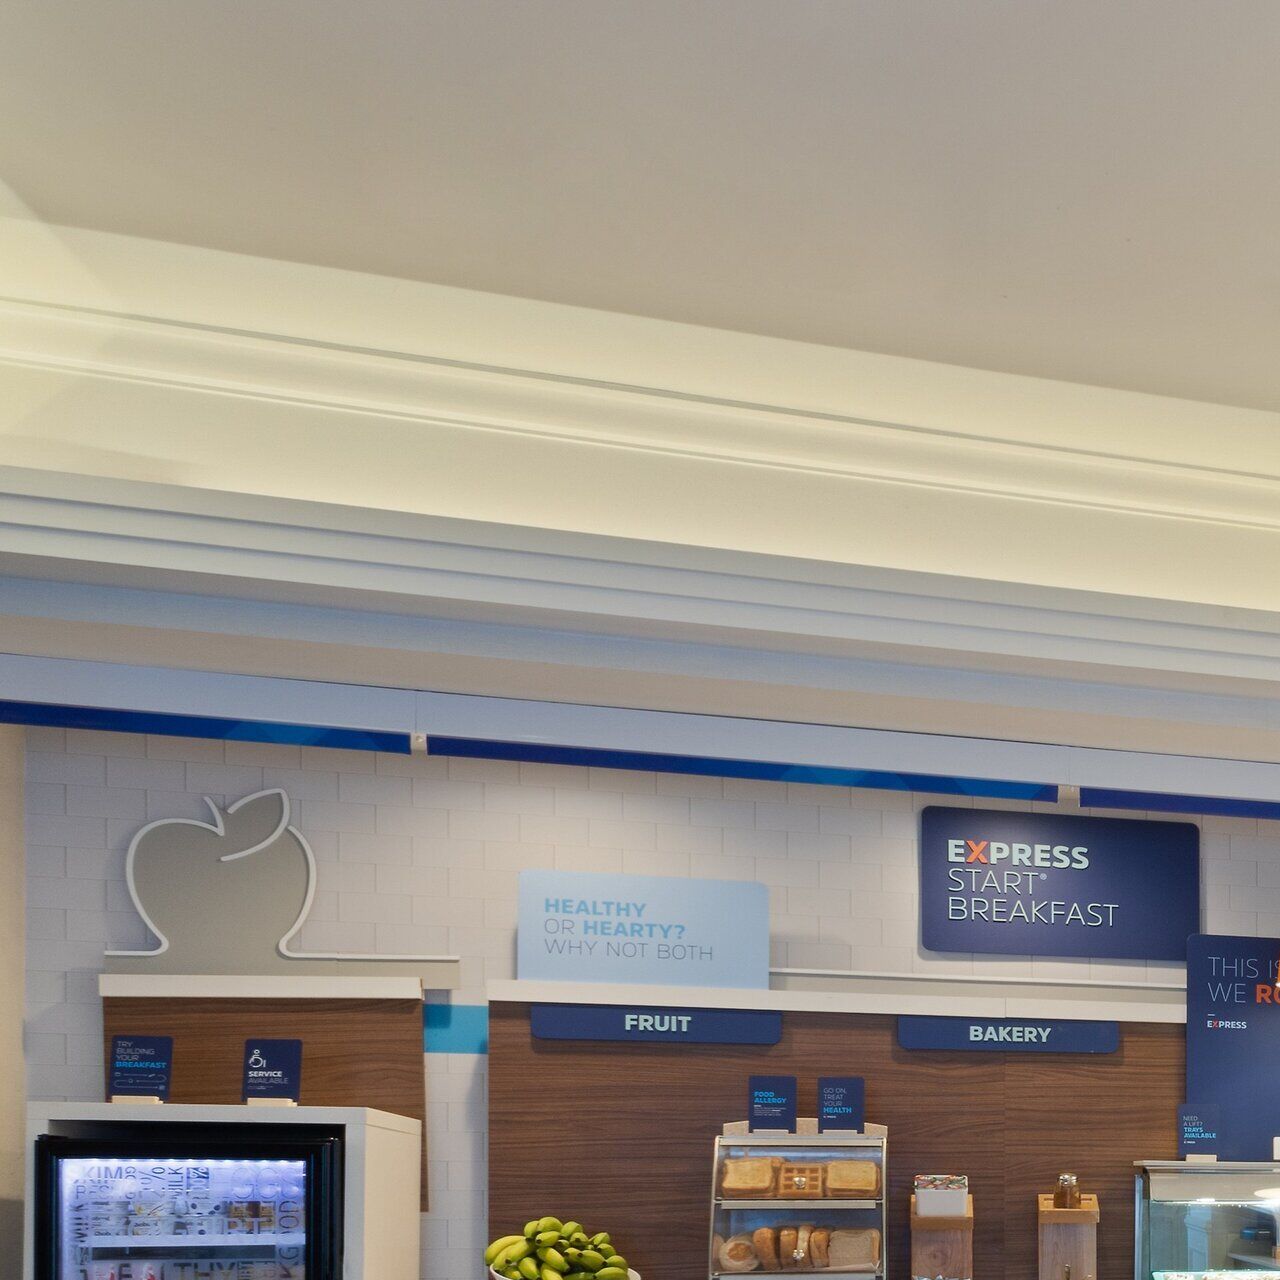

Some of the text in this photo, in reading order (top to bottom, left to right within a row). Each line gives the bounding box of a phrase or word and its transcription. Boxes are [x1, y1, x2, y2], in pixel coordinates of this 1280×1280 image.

[947, 839, 1090, 870] EXPRESS
[544, 898, 647, 918] HEALTHY
[948, 896, 1119, 927] BREAKFAST
[544, 918, 685, 939] OR HEARTY?
[544, 938, 713, 961] WHY NOT BOTH
[1207, 956, 1259, 978] THIS
[1207, 982, 1246, 1003] WE
[625, 1014, 692, 1032] FRUIT
[1207, 1020, 1247, 1029] EXPRESS
[969, 1025, 1052, 1043] BAKERY
[115, 1061, 167, 1069] BREAKFAST
[247, 1077, 289, 1085] AVAILABLE
